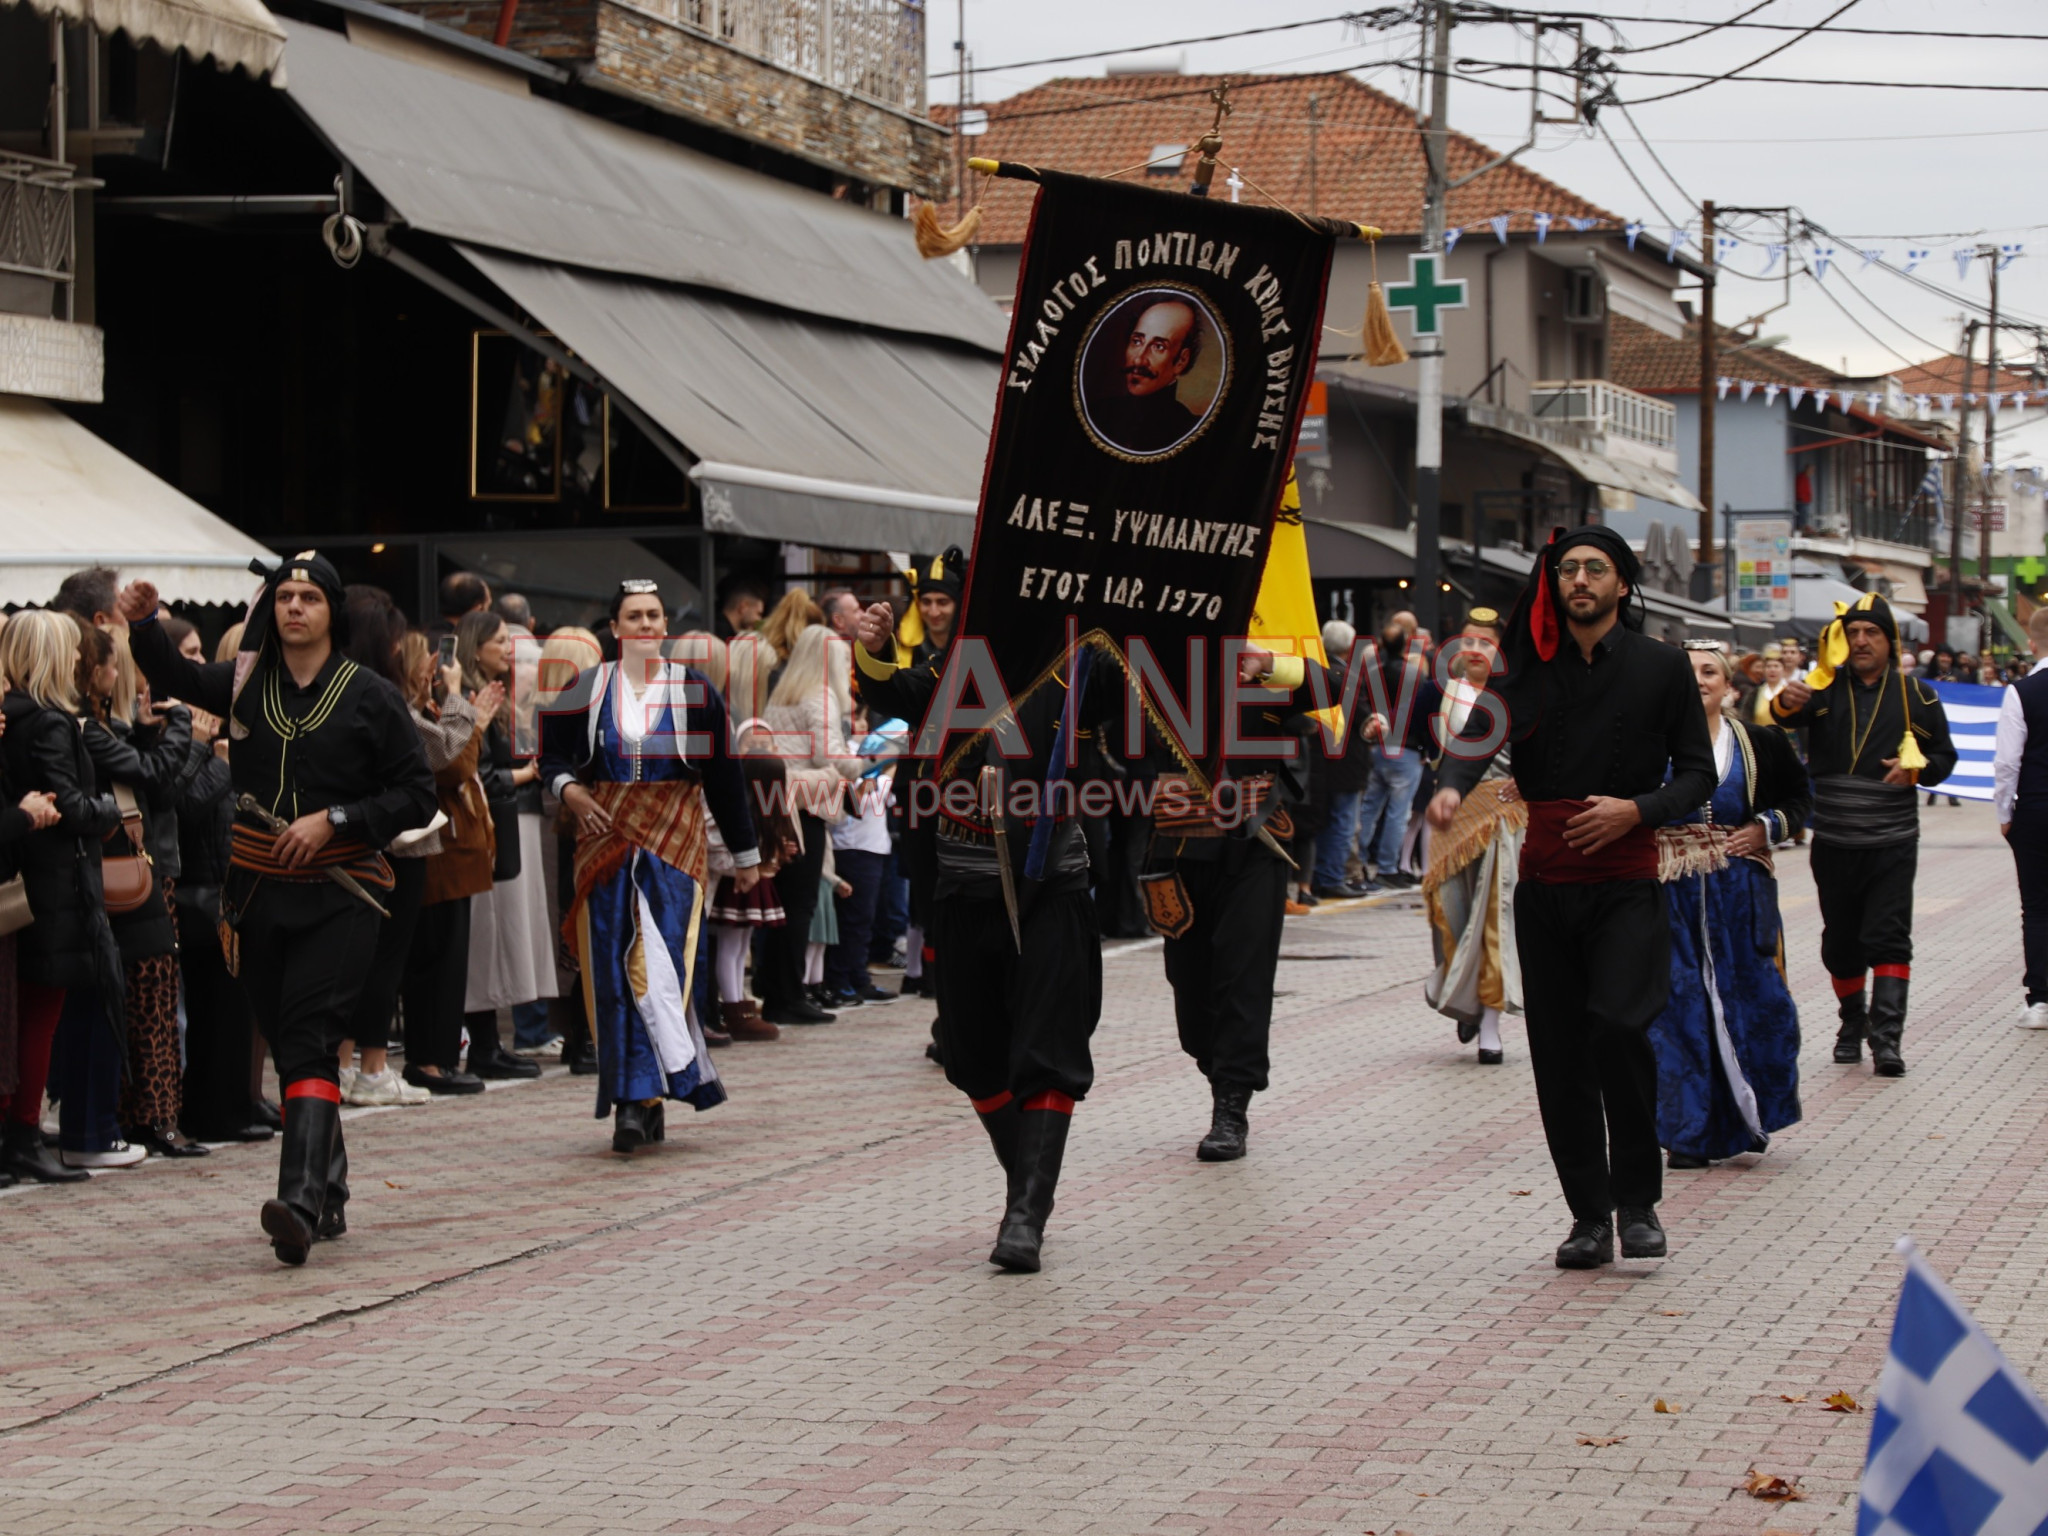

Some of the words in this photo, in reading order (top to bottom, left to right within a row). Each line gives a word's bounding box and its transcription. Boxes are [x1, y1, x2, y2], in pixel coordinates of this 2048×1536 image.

[1114, 231, 1240, 279] ΠΟΝΤΙΩΝ
[1006, 255, 1107, 393] ΣΥΛΛΟΓΟΣ
[1243, 264, 1291, 343] ΚΡΥΑΣ
[1251, 344, 1294, 449] ΒΡΥΣΗΣ
[1007, 494, 1095, 540] ΑΛΕΞ.
[1111, 509, 1261, 557] ΥΨΗΛΑΝΤΗΣ
[1019, 566, 1090, 603] ΕΤΟΣ
[1103, 576, 1144, 609] ΙΔΡ.
[1156, 585, 1222, 621] 1970
